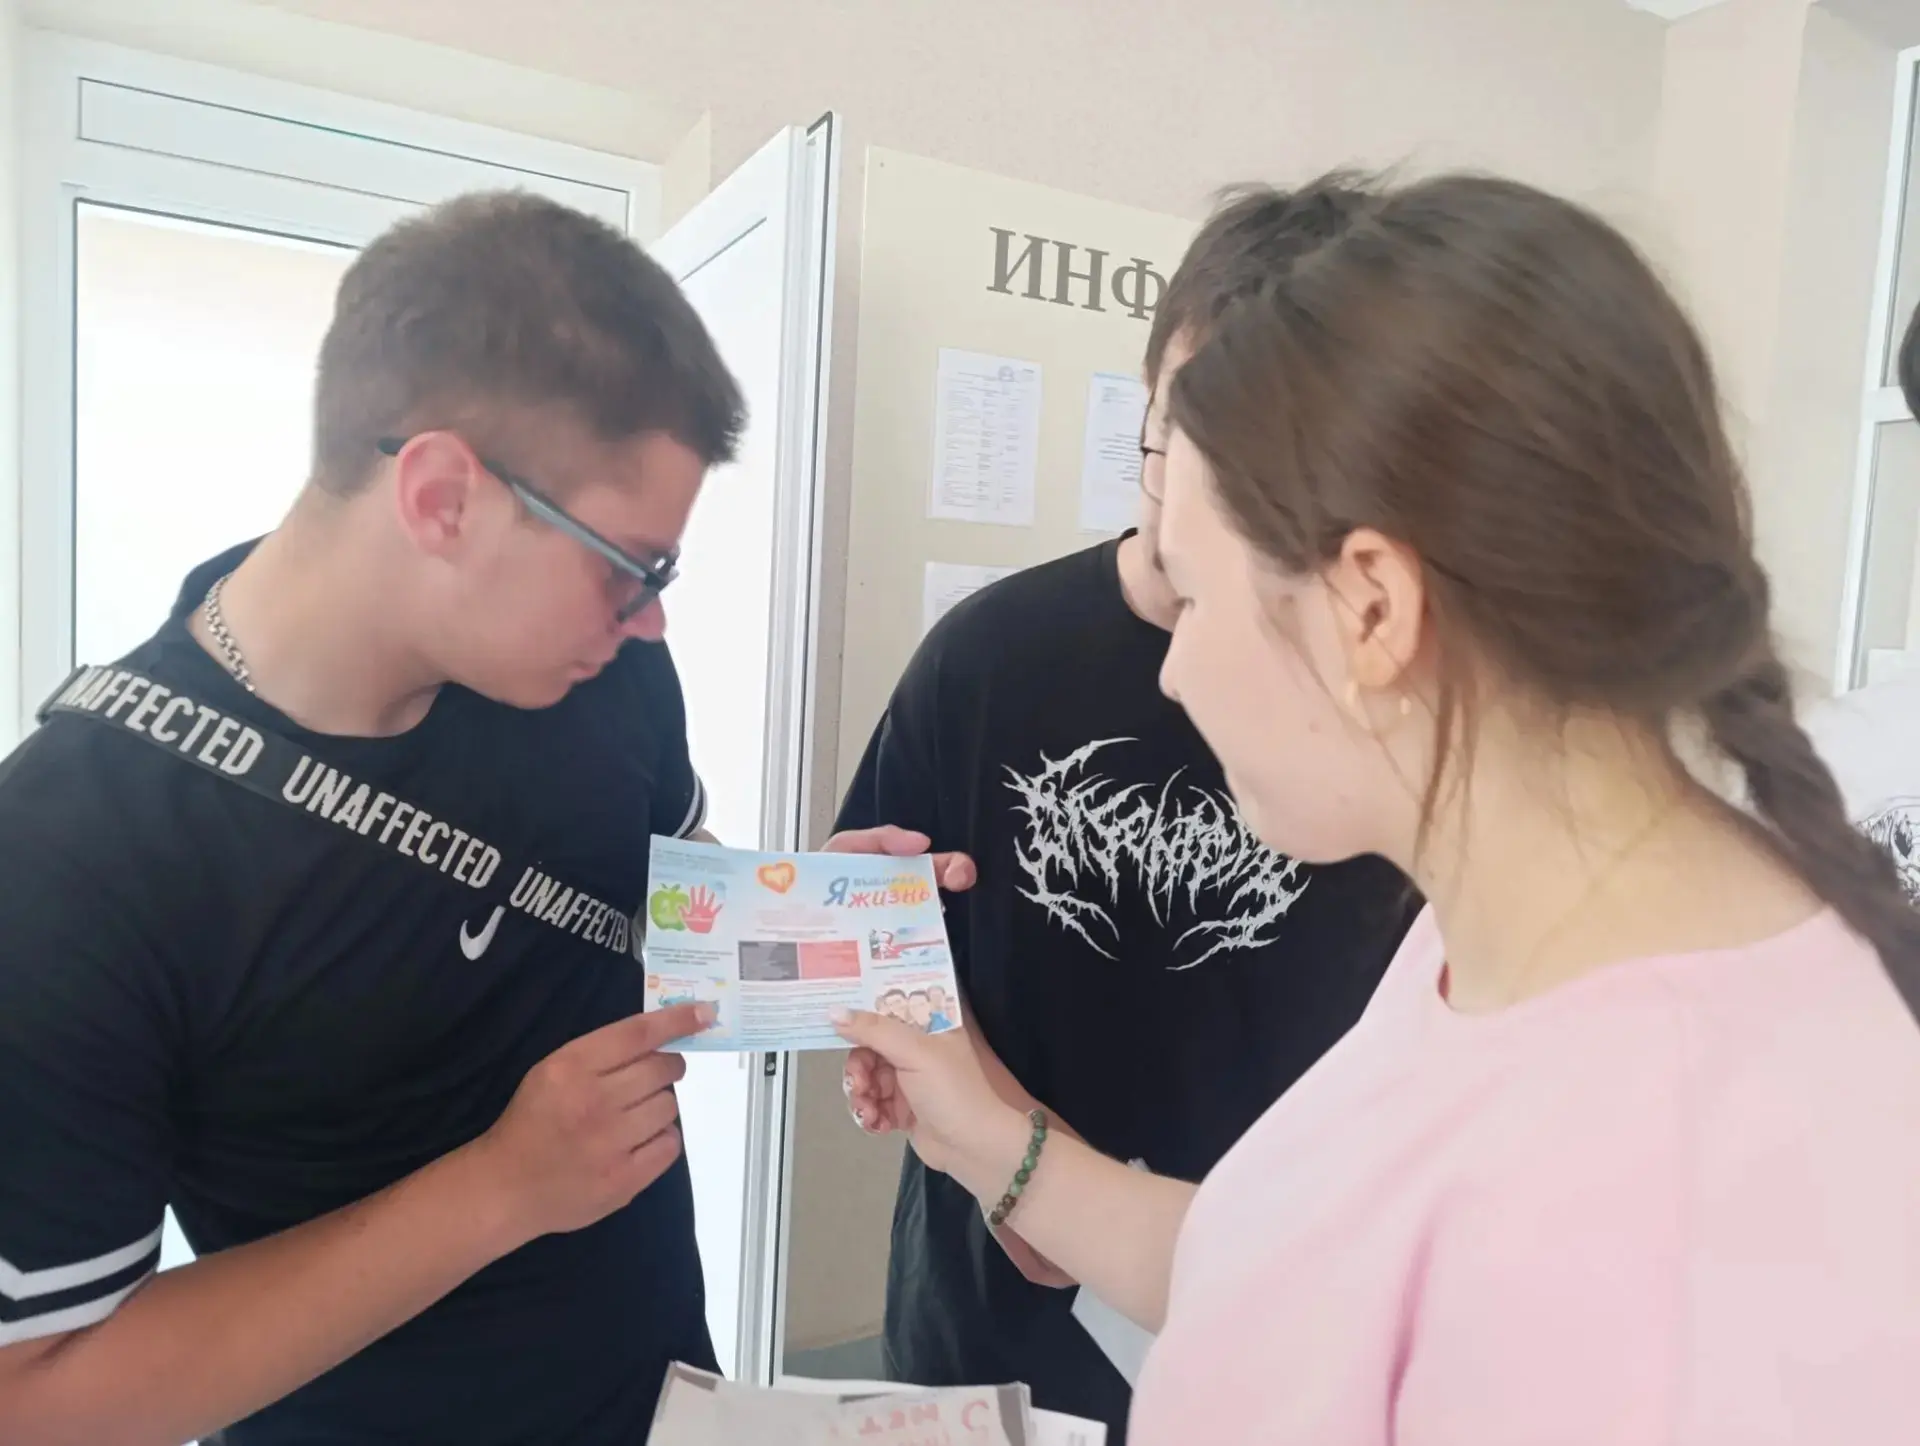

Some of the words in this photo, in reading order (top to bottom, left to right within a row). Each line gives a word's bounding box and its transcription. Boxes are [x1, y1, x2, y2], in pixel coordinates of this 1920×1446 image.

[986, 225, 1168, 321] ИНФ
[56, 666, 265, 776] NAFFECTED
[282, 755, 502, 889] UNAFFECTED
[509, 866, 629, 954] UNAFFECTED
[823, 876, 849, 907] Я
